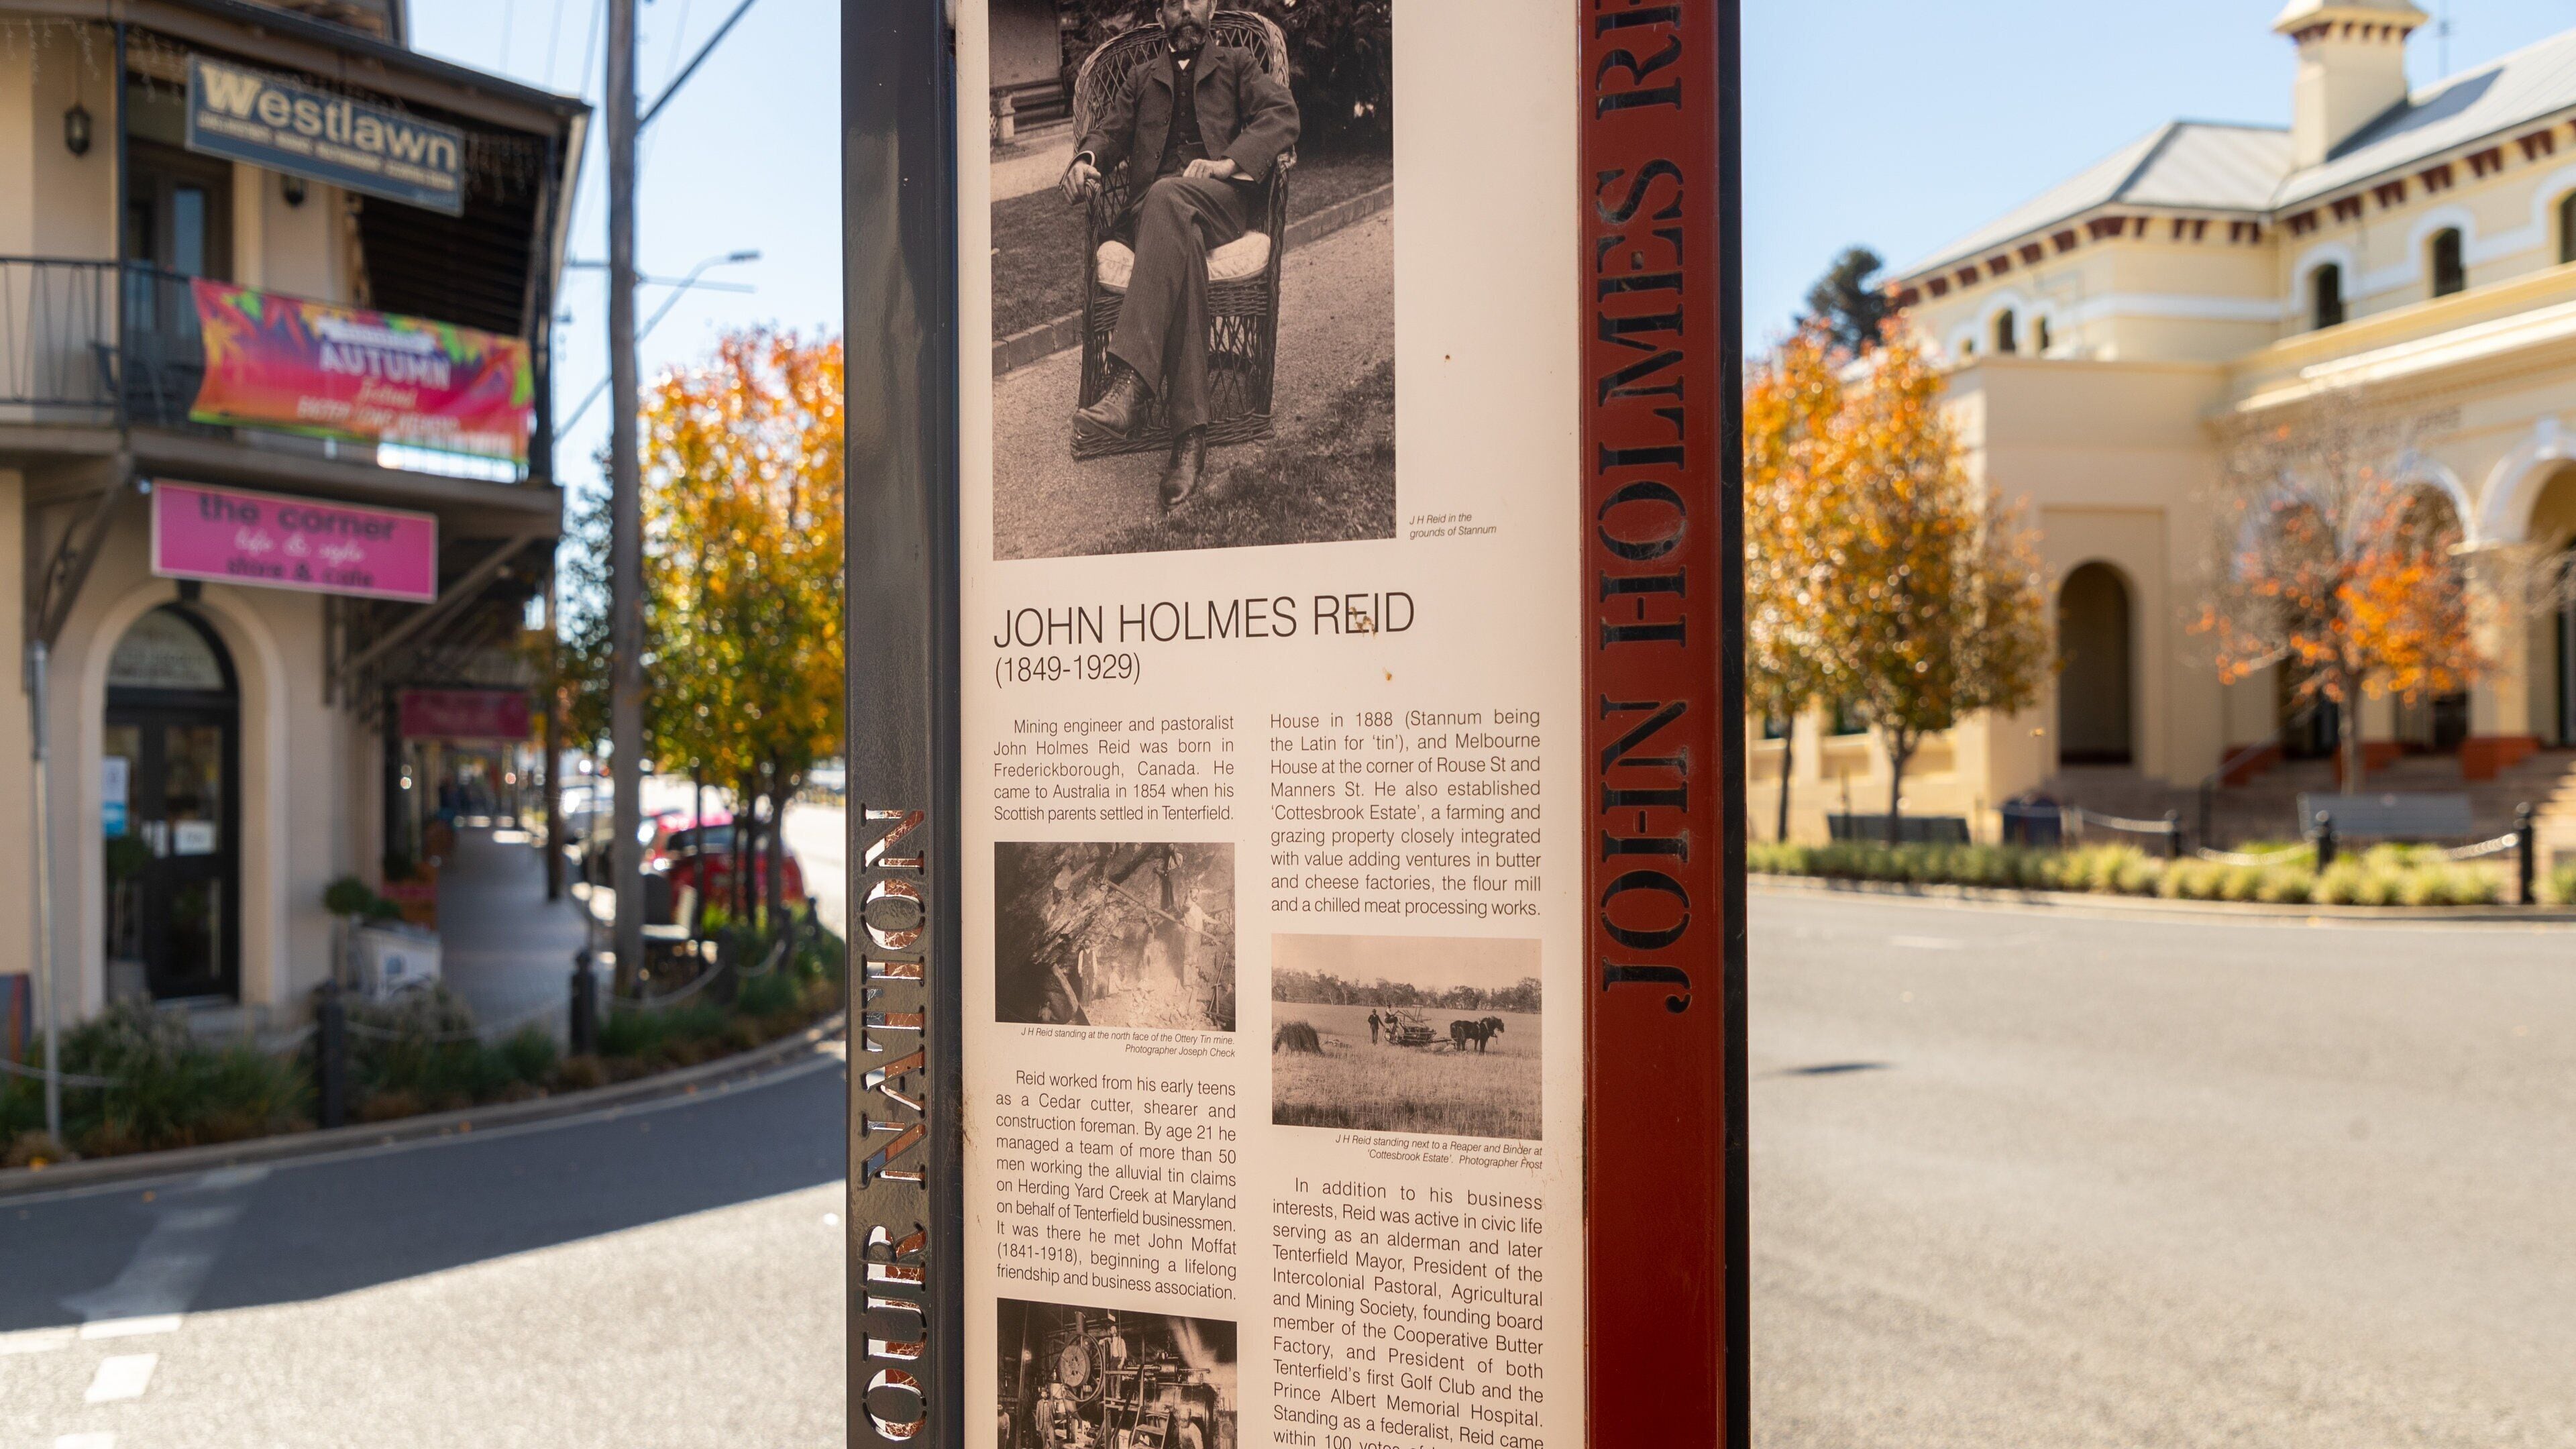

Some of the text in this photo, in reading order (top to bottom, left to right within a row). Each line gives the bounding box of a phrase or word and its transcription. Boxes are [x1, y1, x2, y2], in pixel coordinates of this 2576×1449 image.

[200, 64, 457, 172] Westlawn
[319, 341, 451, 390] AUTUMN
[1596, 157, 1688, 651] HOLMES
[199, 492, 397, 542] the corner
[1409, 513, 1472, 525] J H Reid in the
[1410, 526, 1497, 540] grounds of Stannum
[994, 591, 1415, 649] JOHN HOLMES REID
[996, 651, 1140, 690] (1849-1929)
[1014, 714, 1234, 737] Mining engineer and pastoralist
[1271, 708, 1540, 730] House in 1888 (Stannum being
[993, 737, 1234, 756] John Holmes Reid was born in
[1270, 736, 1293, 752] the
[1301, 735, 1336, 751] Latin
[1344, 735, 1364, 751] for
[1417, 733, 1447, 750] and
[1456, 732, 1540, 749] Melbourne
[994, 759, 1234, 780] Frederickborough, Canada. He
[1271, 755, 1540, 775] House at the corner of Rouse St and
[994, 782, 1234, 799] came to Australia in 1854 when his
[1271, 780, 1540, 798] Manners St. He also established
[994, 804, 1234, 824] Scottish parents settled in Tenterfield.
[1600, 692, 1692, 1014] JOHN
[1021, 1027, 1026, 1036] J
[1028, 1028, 1034, 1036] H
[1036, 1028, 1053, 1036] Reid
[1055, 1030, 1086, 1040] standing
[1097, 1031, 1109, 1039] the
[1111, 1032, 1130, 1040] north
[1132, 1032, 1148, 1041] face
[1151, 1033, 1159, 1041] of
[1161, 1034, 1172, 1042] the
[1175, 1034, 1197, 1045] Ottery
[1201, 1035, 1211, 1043] Tin
[1214, 1036, 1234, 1044] mine.
[1126, 1044, 1235, 1058] Photographer Joseph Check
[1016, 1069, 1236, 1098] Reid worked from his early teens
[996, 1092, 1236, 1119] as a Cedar cutter, shearer and
[860, 802, 928, 1442] OUR NATION
[996, 1114, 1236, 1142] construction foreman. By age 21 he
[1336, 1134, 1341, 1143] J
[1343, 1134, 1350, 1143] H
[1352, 1135, 1371, 1144] Reid
[1373, 1138, 1409, 1149] standing
[1432, 1141, 1440, 1149] to
[1450, 1141, 1481, 1153] Reaper
[1484, 1144, 1501, 1152] and
[1503, 1144, 1532, 1155] Binder
[1534, 1147, 1542, 1156] at
[1459, 1155, 1518, 1169] Photographer
[1521, 1159, 1543, 1169] Frost
[1295, 1177, 1544, 1210] In addition to his business
[1273, 1198, 1543, 1234] interests, Reid was active in civic life
[1272, 1244, 1543, 1283] Tenterfield Mayor, President of the
[1273, 1267, 1542, 1307] Intercolonial Pastoral, Agricultural
